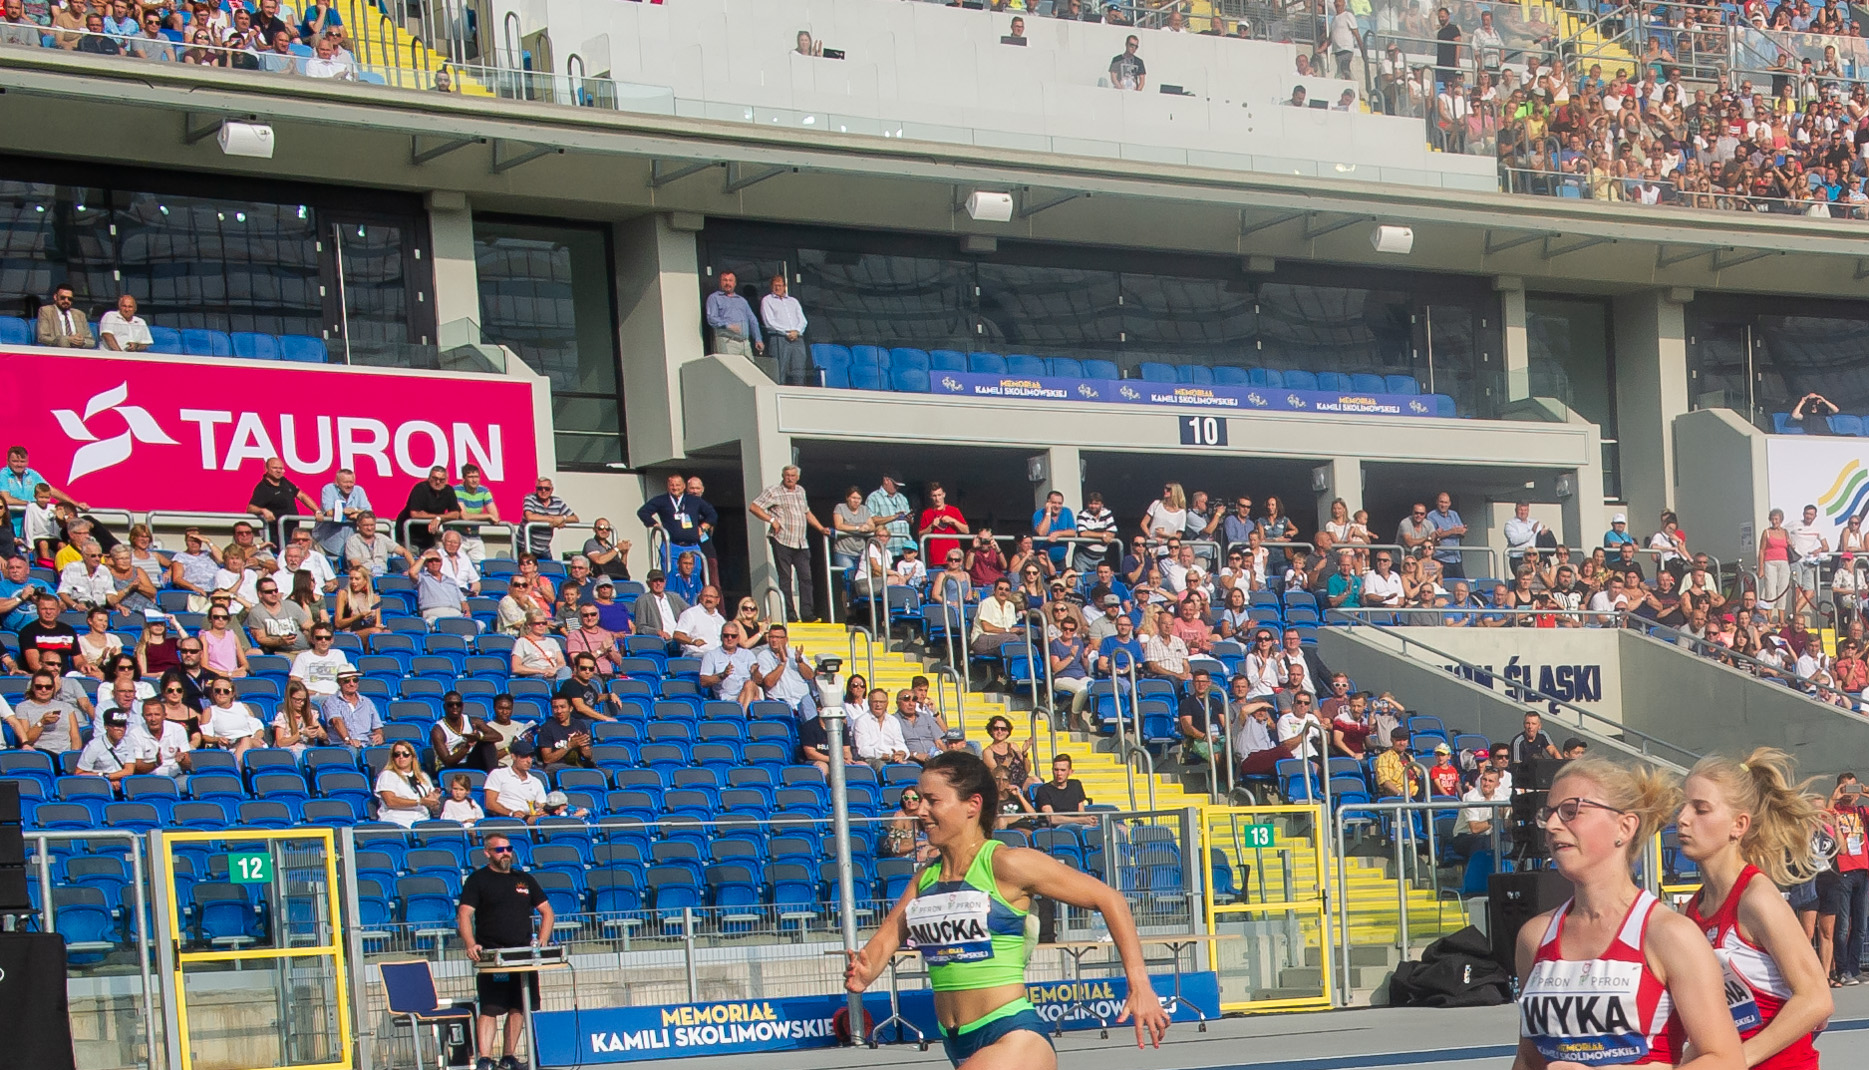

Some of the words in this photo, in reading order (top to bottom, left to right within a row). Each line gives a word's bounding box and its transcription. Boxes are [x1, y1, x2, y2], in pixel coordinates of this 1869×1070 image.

[179, 408, 505, 482] TAURON
[1188, 417, 1219, 445] 10
[1503, 655, 1602, 715] ŚLĄSKI
[1251, 827, 1269, 845] 13
[237, 857, 264, 879] 12
[1538, 976, 1570, 987] PFRON
[1591, 975, 1630, 987] PFRON
[661, 1002, 777, 1027] MEMORIAŁ
[1524, 996, 1634, 1035] WYKA
[591, 1028, 670, 1053] KAMILI
[675, 1018, 835, 1047] SKOLIMOWSKIE
